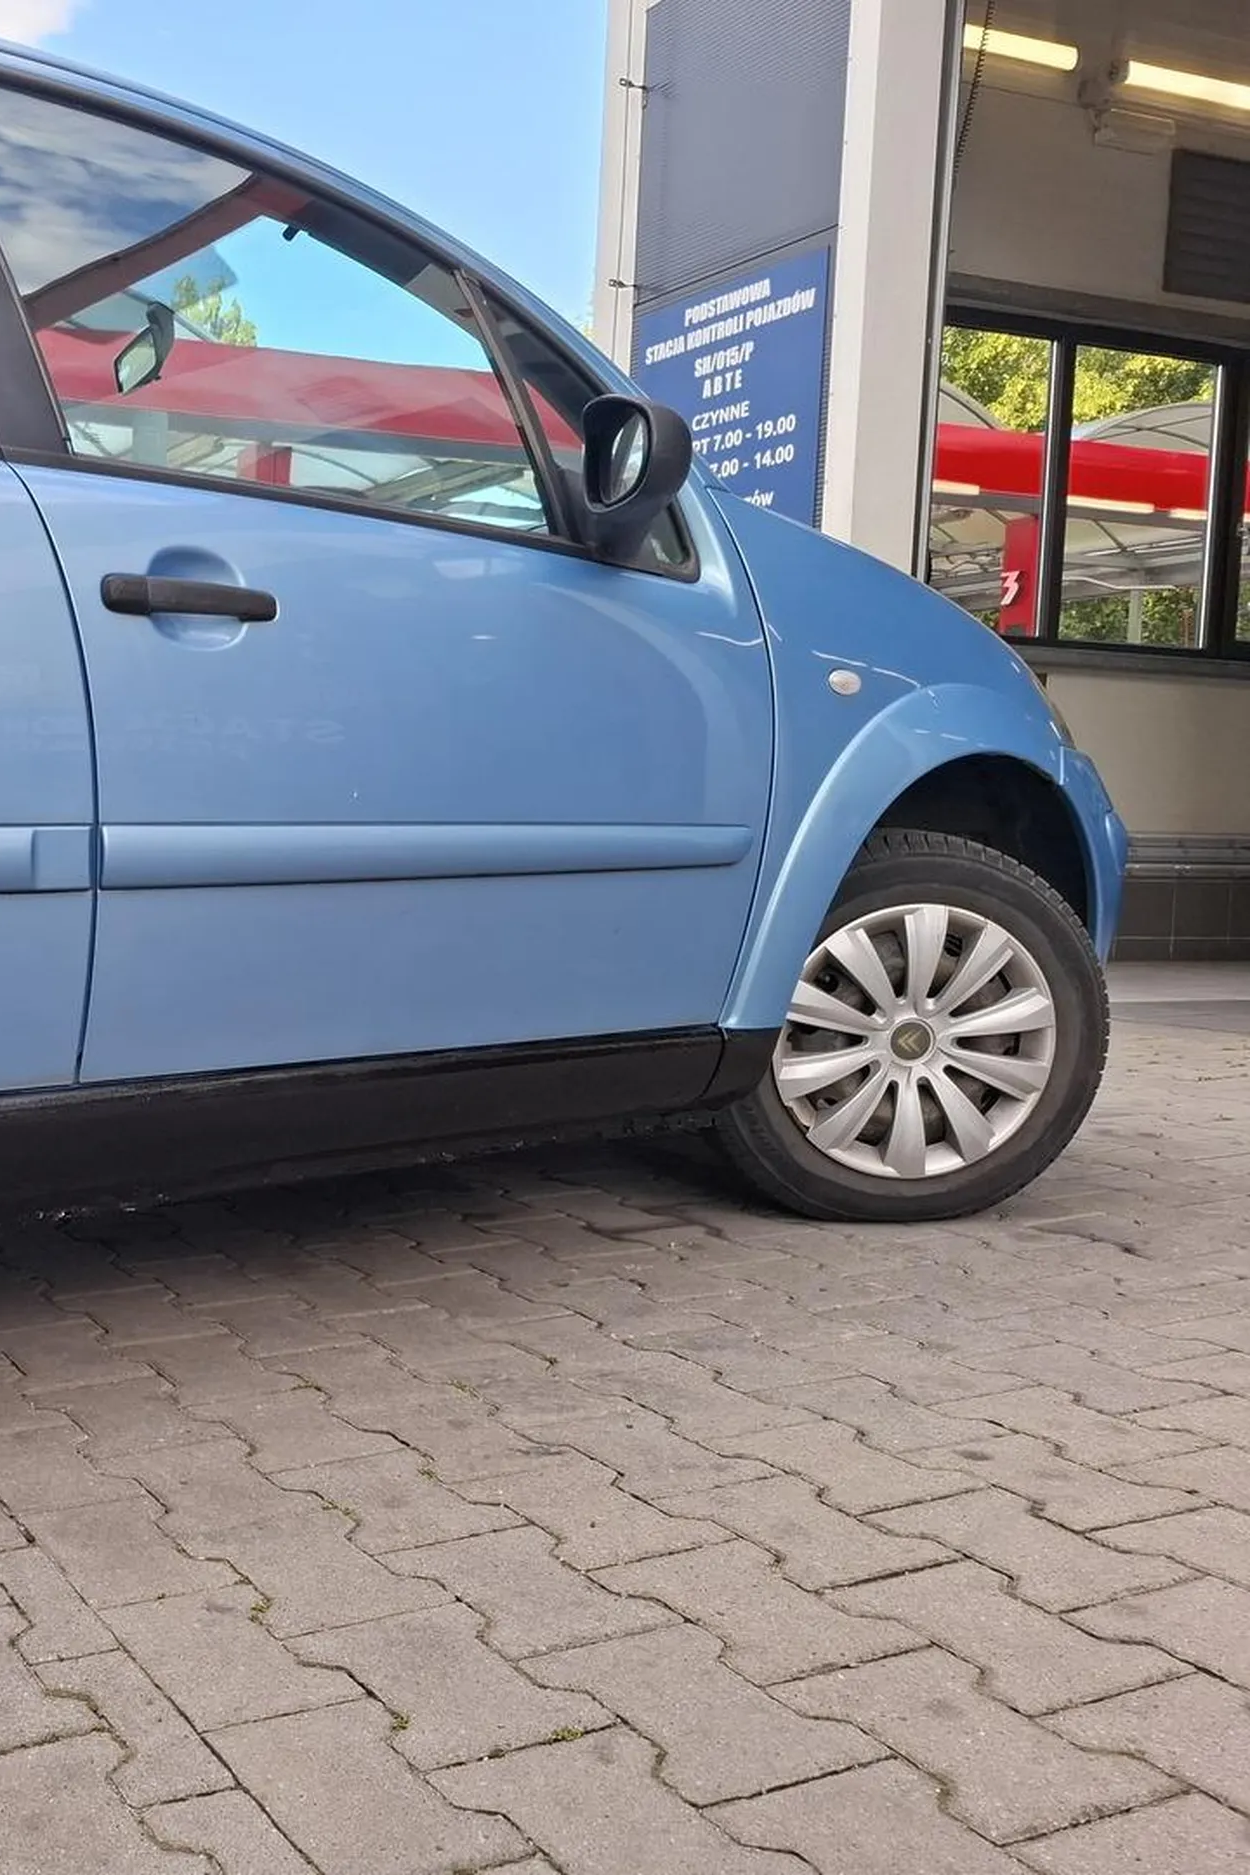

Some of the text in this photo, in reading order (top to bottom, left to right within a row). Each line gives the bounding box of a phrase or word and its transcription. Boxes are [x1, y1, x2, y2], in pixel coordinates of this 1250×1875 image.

[684, 278, 771, 327] PODSTAWOWA
[645, 288, 817, 365] STACJA KONTROLI POJAZDÓW
[692, 400, 750, 431] CZYNNE
[713, 428, 743, 452] 7.00
[755, 414, 796, 440] 19.00
[753, 444, 795, 470] 14.00
[1000, 570, 1020, 606] 3
